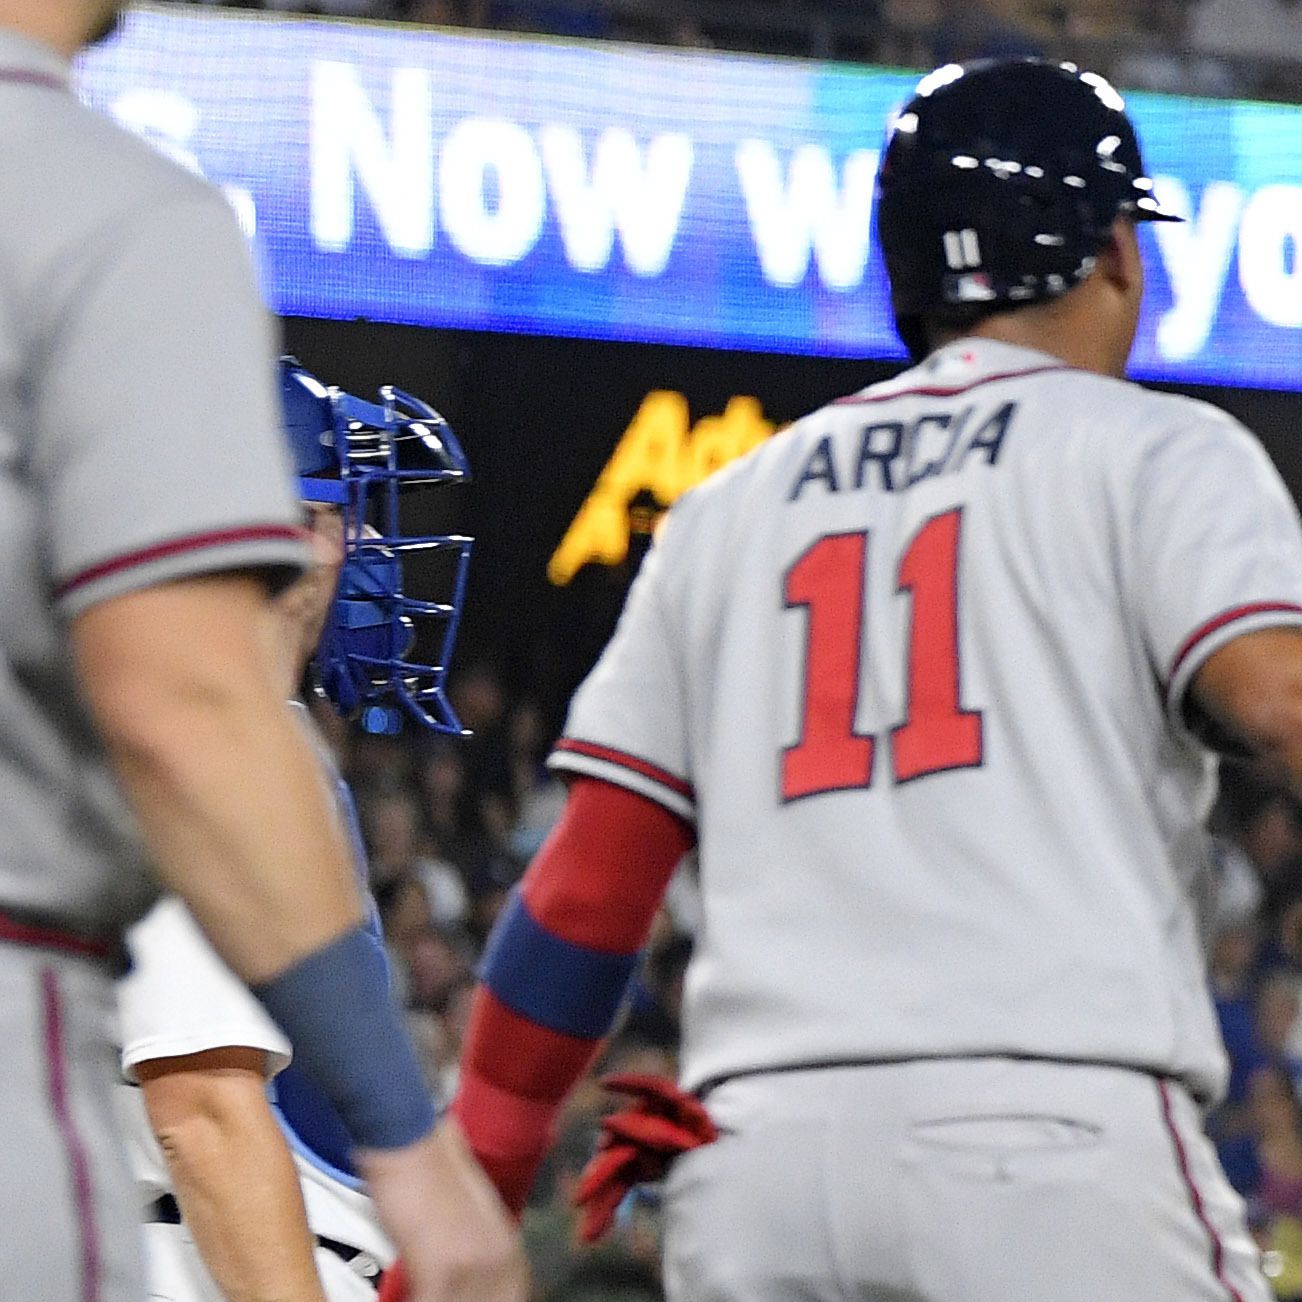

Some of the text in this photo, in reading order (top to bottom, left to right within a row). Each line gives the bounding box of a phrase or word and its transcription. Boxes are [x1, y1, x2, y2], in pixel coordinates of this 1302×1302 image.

[308, 58, 694, 277] Now
[788, 402, 1020, 502] ARCIA
[778, 505, 985, 806] 11
